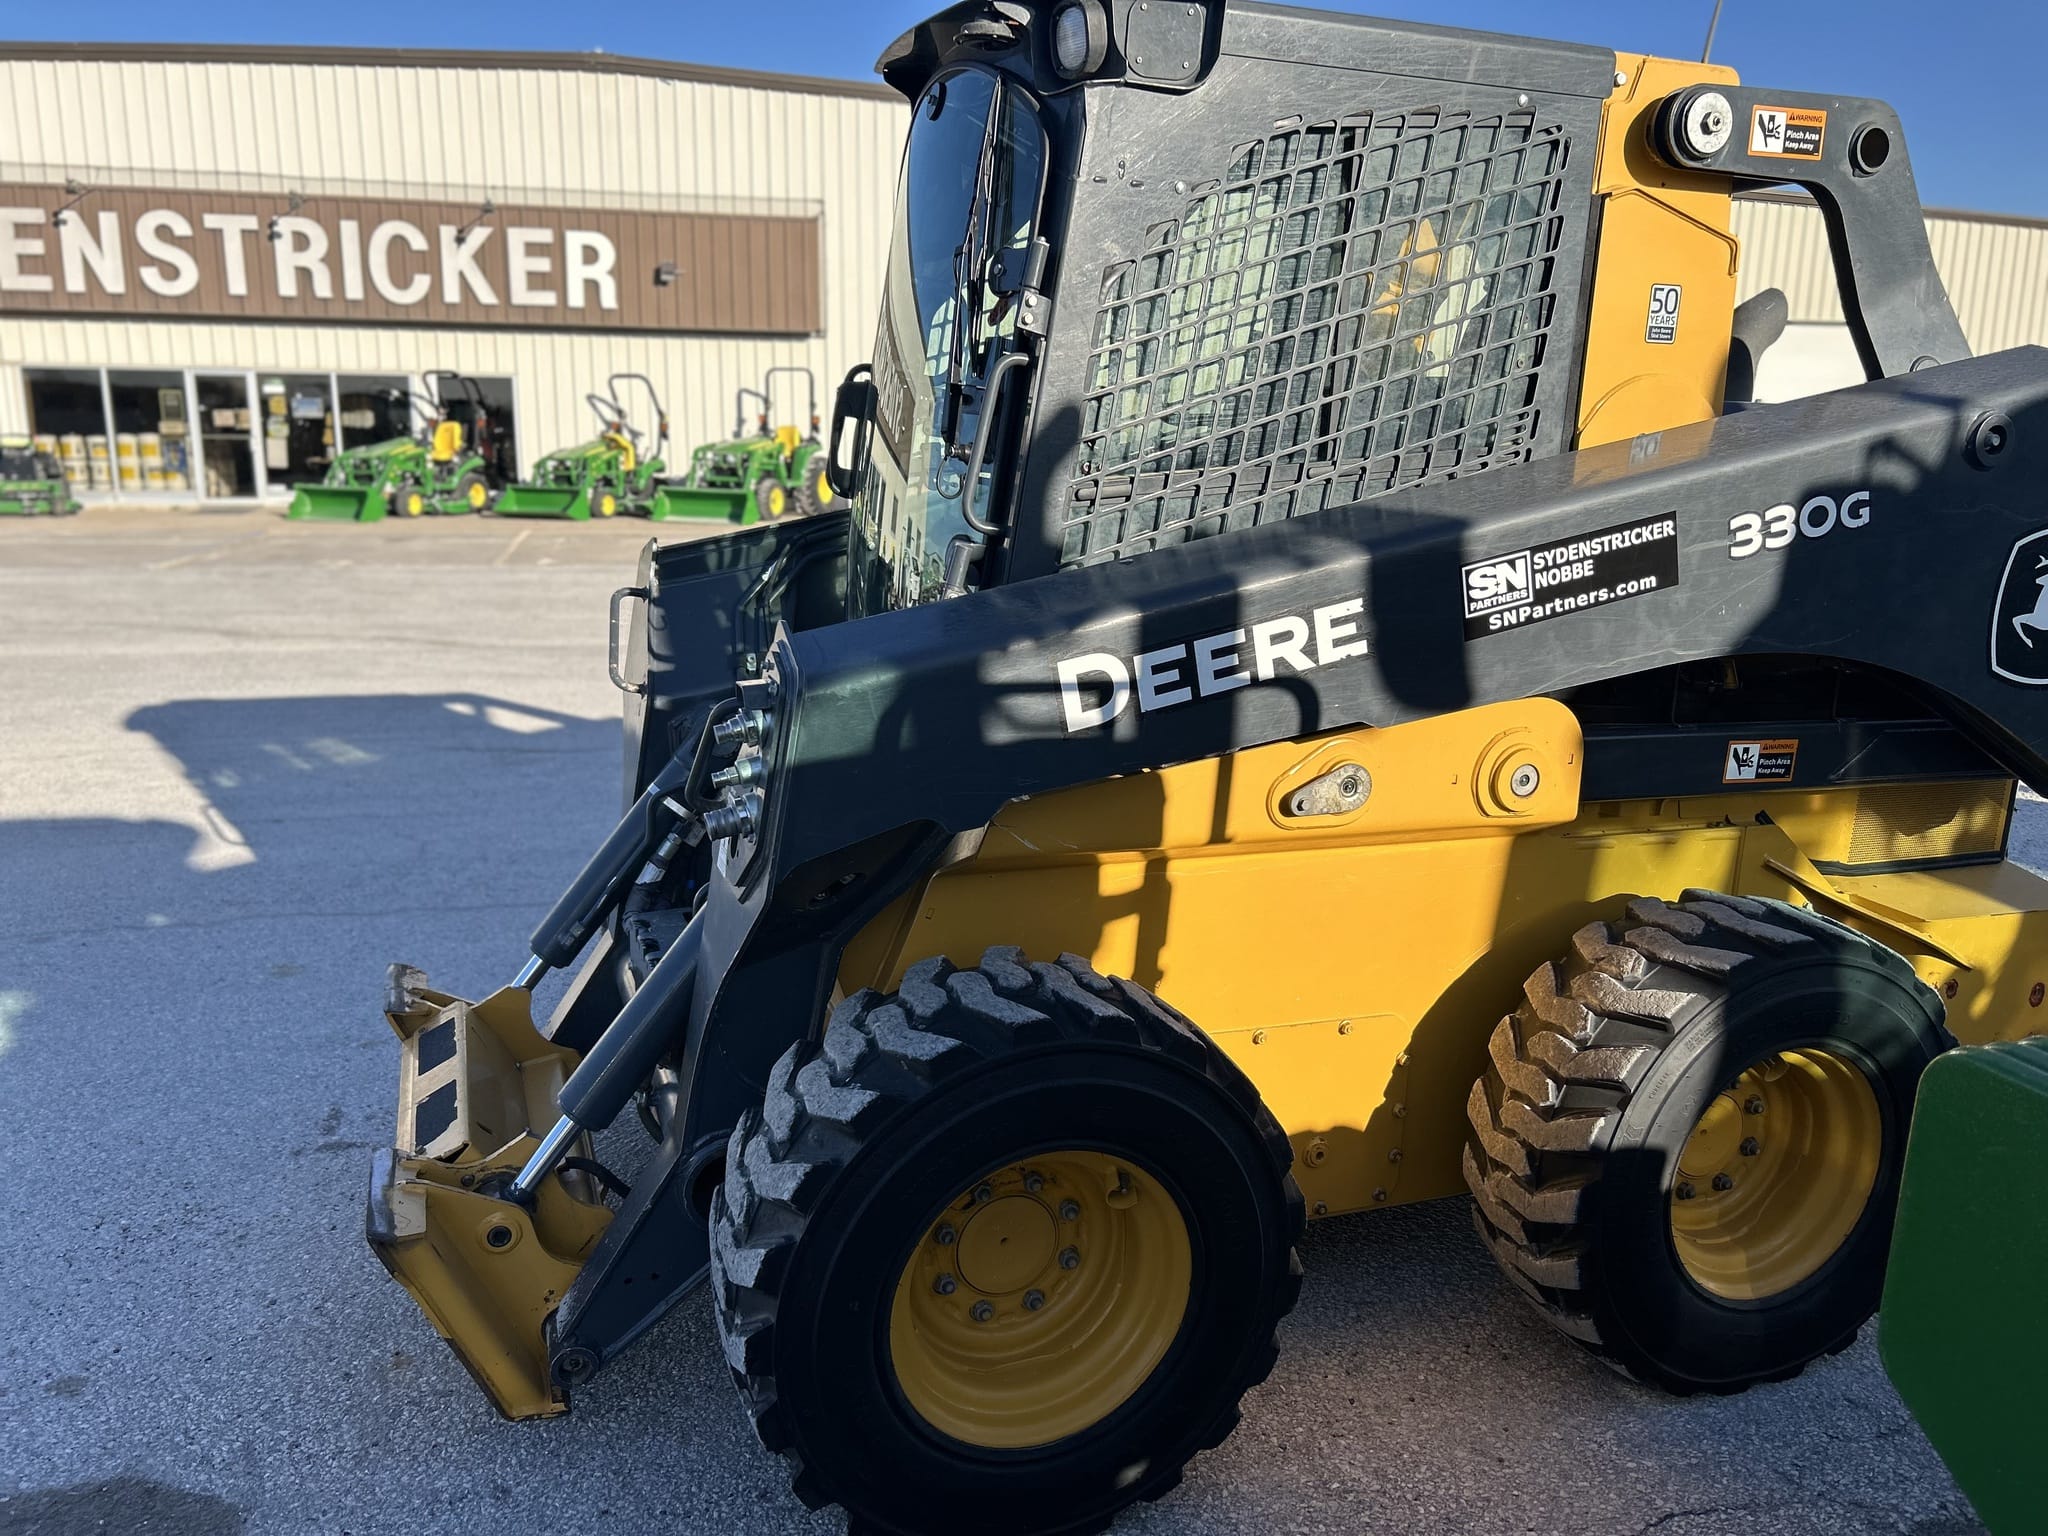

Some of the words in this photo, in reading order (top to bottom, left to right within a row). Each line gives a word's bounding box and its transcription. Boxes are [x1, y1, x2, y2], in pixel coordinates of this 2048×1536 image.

[1795, 114, 1823, 123] WARNING
[1785, 140, 1799, 150] Keep
[1799, 142, 1814, 151] Away
[1786, 130, 1803, 140] Pinch
[1804, 131, 1819, 140] Area
[0, 206, 618, 310] ENSTRICKER
[1651, 287, 1679, 315] 50
[1650, 315, 1675, 326] YEARS
[1729, 490, 1870, 558] 330G
[1533, 519, 1676, 571] SYDENSTRICKER
[1467, 557, 1528, 600] SN
[1534, 559, 1595, 590] NOBBE
[1470, 589, 1528, 612] PARTNERS
[1488, 574, 1657, 630] SNPartners.com
[1056, 597, 1368, 733] DEERE
[1759, 758, 1776, 766] Pinch
